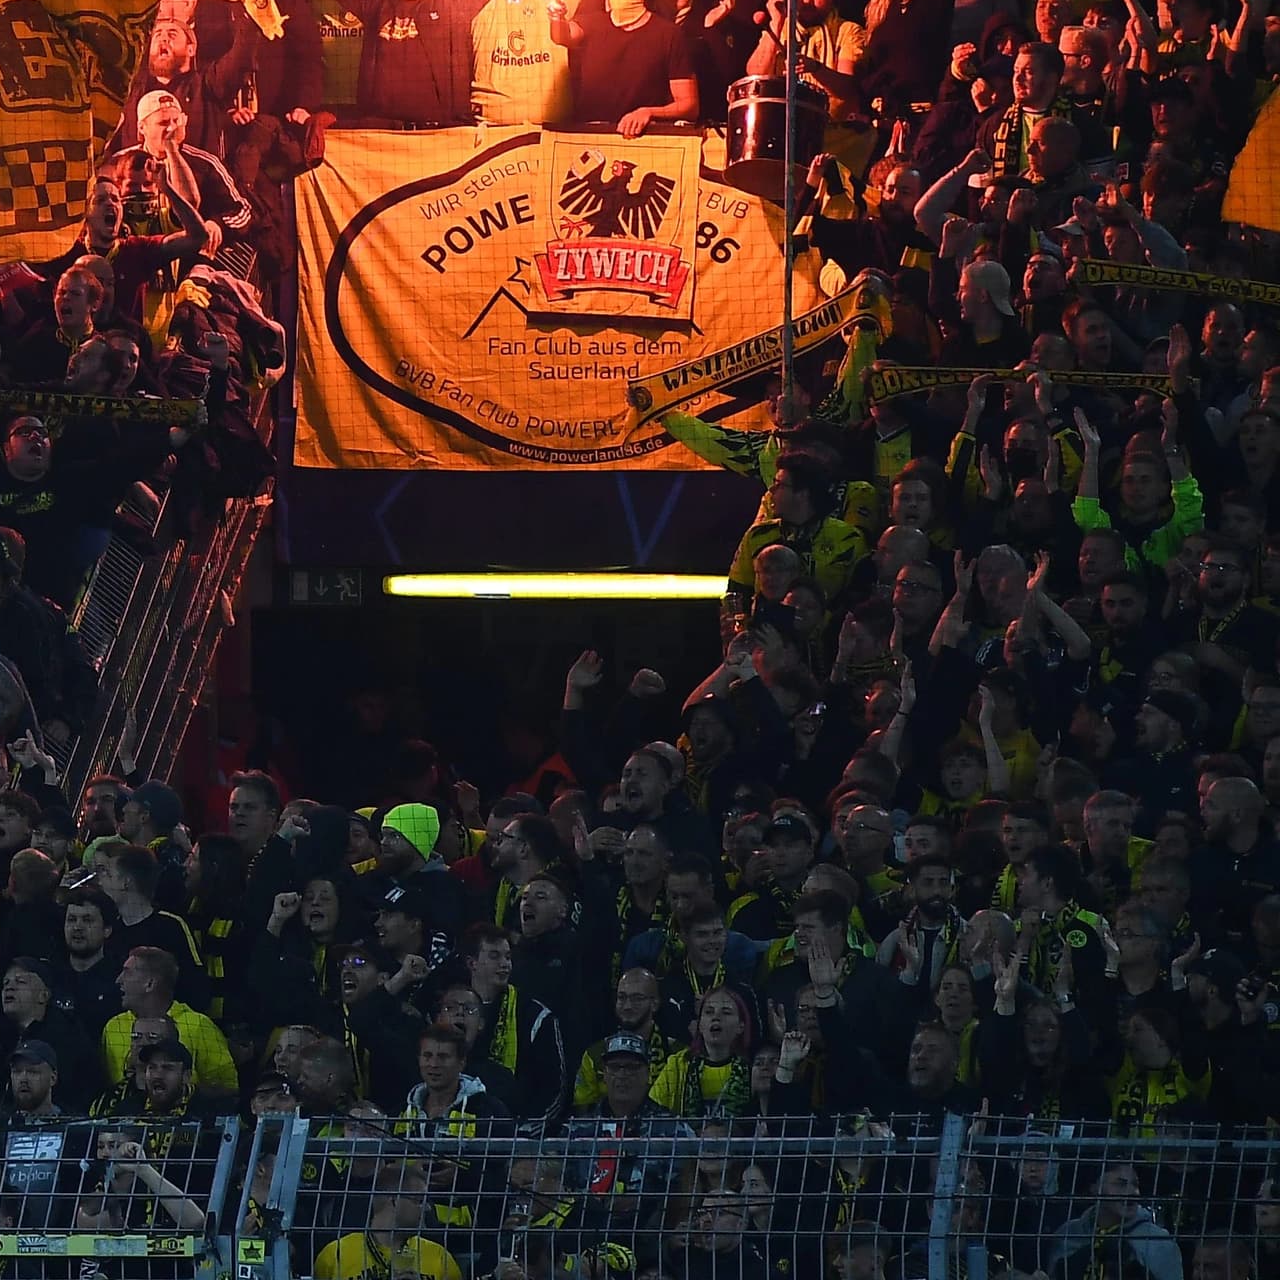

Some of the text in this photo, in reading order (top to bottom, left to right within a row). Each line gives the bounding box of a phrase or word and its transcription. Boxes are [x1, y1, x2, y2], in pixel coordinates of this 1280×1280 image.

[420, 160, 530, 221] WIR stehen
[706, 191, 752, 219] BVB
[421, 194, 536, 273] POWE
[696, 222, 742, 264] 86
[488, 337, 682, 356] Fan Club aus dem
[529, 361, 641, 380] Sauerland
[661, 300, 844, 392] WESTFALENSADION
[395, 360, 621, 440] BVB Fan Club POWERL
